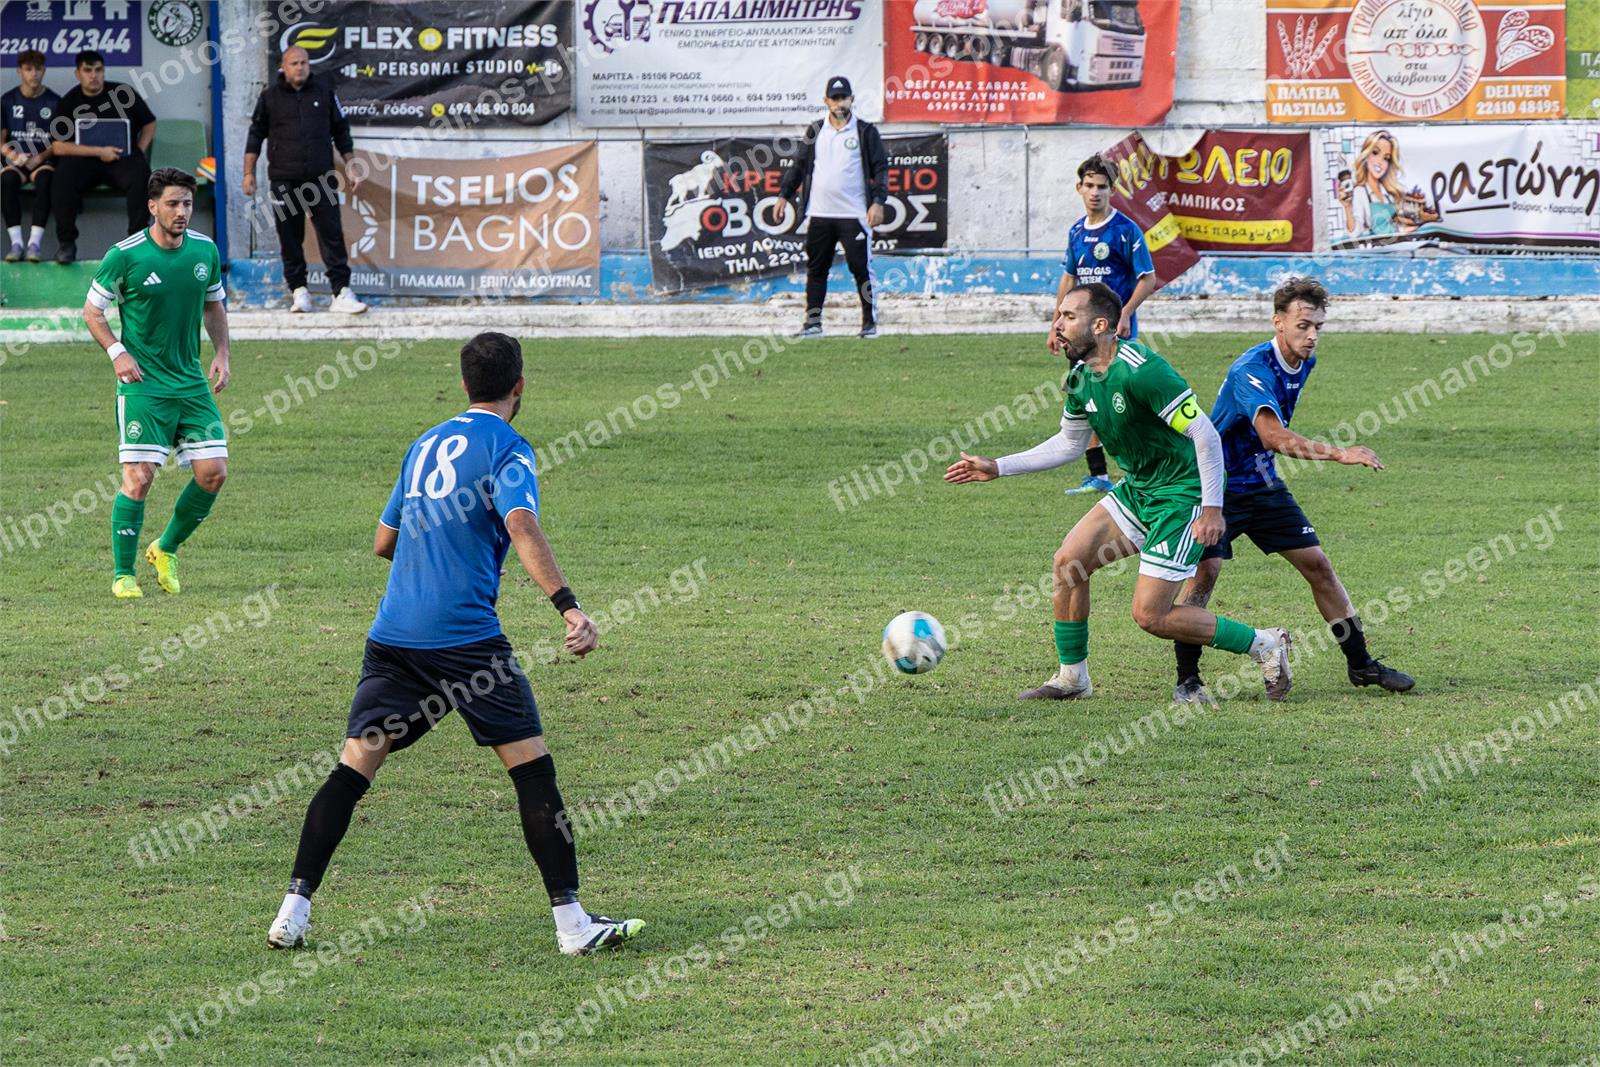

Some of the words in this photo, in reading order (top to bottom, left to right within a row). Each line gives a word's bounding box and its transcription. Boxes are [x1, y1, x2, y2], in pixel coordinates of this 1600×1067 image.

[1397, 3, 1433, 22] λίγο
[344, 26, 413, 50] FLEX
[447, 24, 558, 50] FITNESS
[1415, 24, 1449, 39] όλα
[1, 38, 49, 54] 22410
[52, 28, 131, 54] 62344
[378, 61, 460, 77] PERSONAL
[465, 59, 524, 74] STUDIO
[1404, 62, 1428, 70] στα
[669, 71, 702, 80] ΡΟΔΟΣ
[1386, 72, 1447, 86] κάρβουνα
[886, 90, 967, 101] ΜΕΤΑΦΟΡΕΣ
[971, 91, 1046, 101] ΛΥΜΜΑΤΩΝ
[1277, 85, 1340, 100] ΠΛΑΤΕΙΑ
[1485, 84, 1552, 99] DELIVERY
[12, 104, 24, 118] 12
[383, 102, 425, 118] Ρόδος
[448, 102, 472, 116] 694
[474, 102, 489, 116] 48
[492, 102, 510, 116] 90
[511, 102, 535, 116] 804
[1272, 101, 1346, 116] ΠΑΣΤΙΔΑΣ
[1476, 100, 1515, 115] 22410
[1519, 100, 1560, 113] 48495
[893, 156, 938, 165] ΓΙΩΡΓΟΣ
[411, 163, 580, 207] TSELIOS
[414, 211, 592, 252] BAGNO
[698, 243, 747, 259] ΙΕΡΟΥ
[725, 257, 766, 274] ΤΗΛ.
[1094, 266, 1112, 275] GAS
[351, 272, 385, 286] ΕΙΝΗΣ
[400, 274, 466, 288] ΠΛΑΚΑΚΙΑ
[480, 274, 526, 288] ΕΠΙΠΛΑ
[529, 274, 592, 288] ΚΟΥΖΙΝΑΣ
[1181, 402, 1197, 419] C
[405, 434, 469, 500] 18
